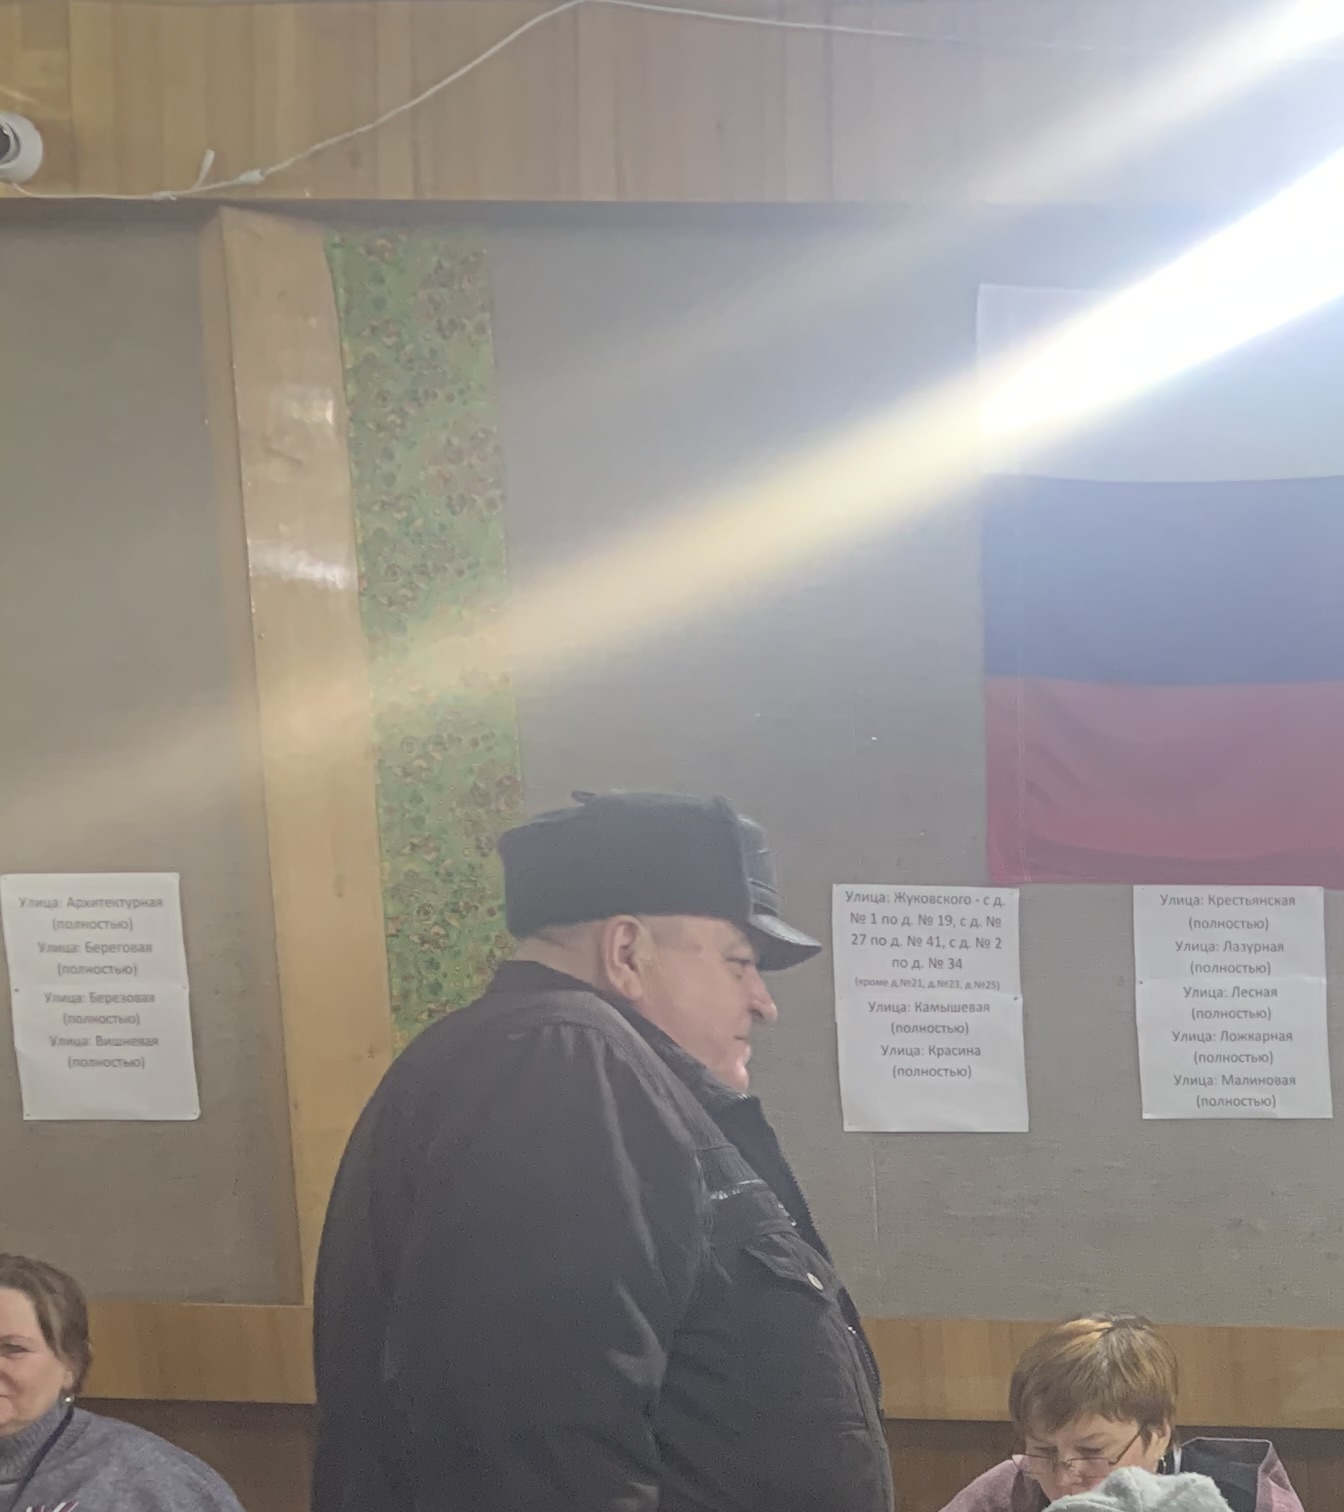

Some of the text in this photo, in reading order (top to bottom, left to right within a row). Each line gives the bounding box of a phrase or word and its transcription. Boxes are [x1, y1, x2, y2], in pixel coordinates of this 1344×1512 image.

[845, 890, 890, 905] Улица:
[894, 892, 972, 906] Жуковского
[983, 896, 989, 906] с
[992, 897, 1005, 908] д.
[1160, 894, 1295, 907] Улица: Крестьянская
[850, 912, 1001, 929] № 1 по д. № 19, с д. №
[1189, 917, 1269, 931] (полностью)
[851, 933, 1002, 950] 27 по д. № 41, с д. № 2
[1175, 940, 1284, 954] Улица: Лазурная
[892, 957, 963, 970] по д. № 34
[1190, 961, 1271, 976] (полностью)
[1183, 986, 1278, 1000] Улица: Лесная
[868, 1001, 990, 1014] Улица: Камышевая
[1191, 1007, 1272, 1021] (полностью)
[891, 1022, 969, 1036] (полностью)
[1172, 1030, 1293, 1044] Улица: Ложкарная
[881, 1045, 981, 1058] Улица: Красина
[1194, 1051, 1274, 1065] (полностью)
[892, 1065, 972, 1079] (полностью)
[1173, 1074, 1296, 1088] Улица: Малиновая
[1196, 1094, 1276, 1108] (полностью)
